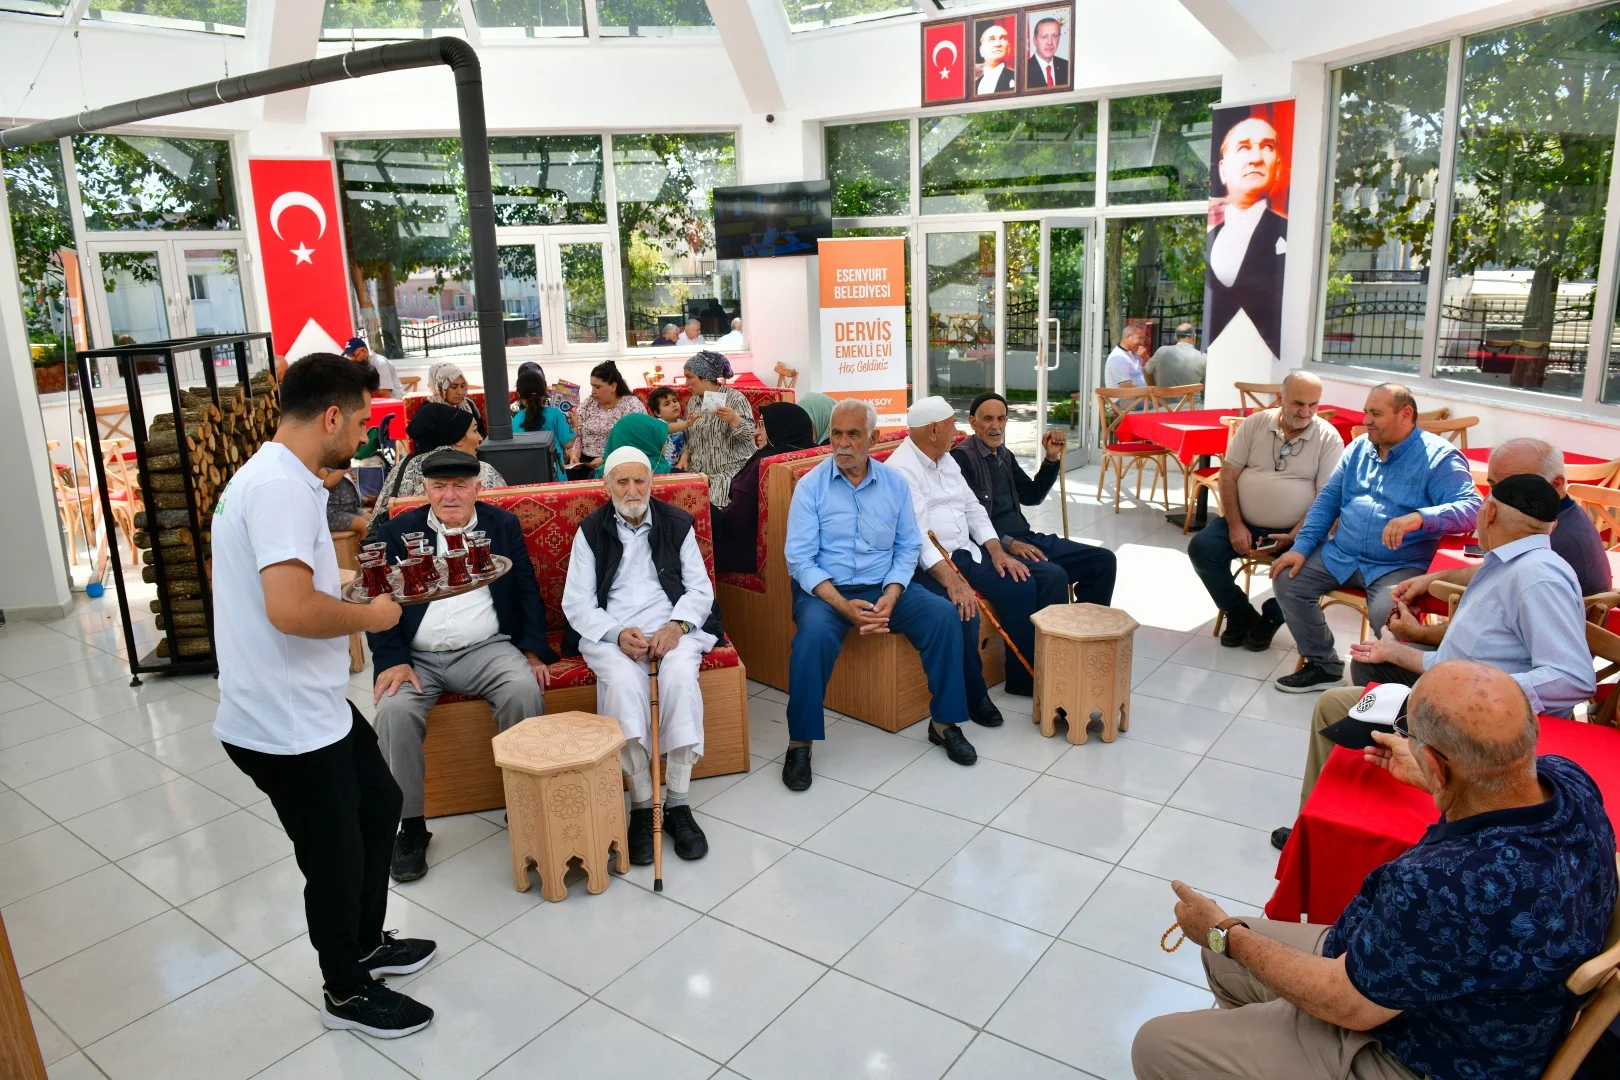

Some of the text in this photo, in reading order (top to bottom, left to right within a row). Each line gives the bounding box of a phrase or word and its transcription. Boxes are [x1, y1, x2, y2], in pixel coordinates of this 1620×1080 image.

[837, 268, 888, 282] ESENYURT
[835, 283, 890, 299] BELEDİYESİ
[835, 318, 891, 343] DERVİŞ
[835, 342, 892, 359] EMEKLİ EVİ
[839, 359, 888, 374] Hoş Geldiniz
